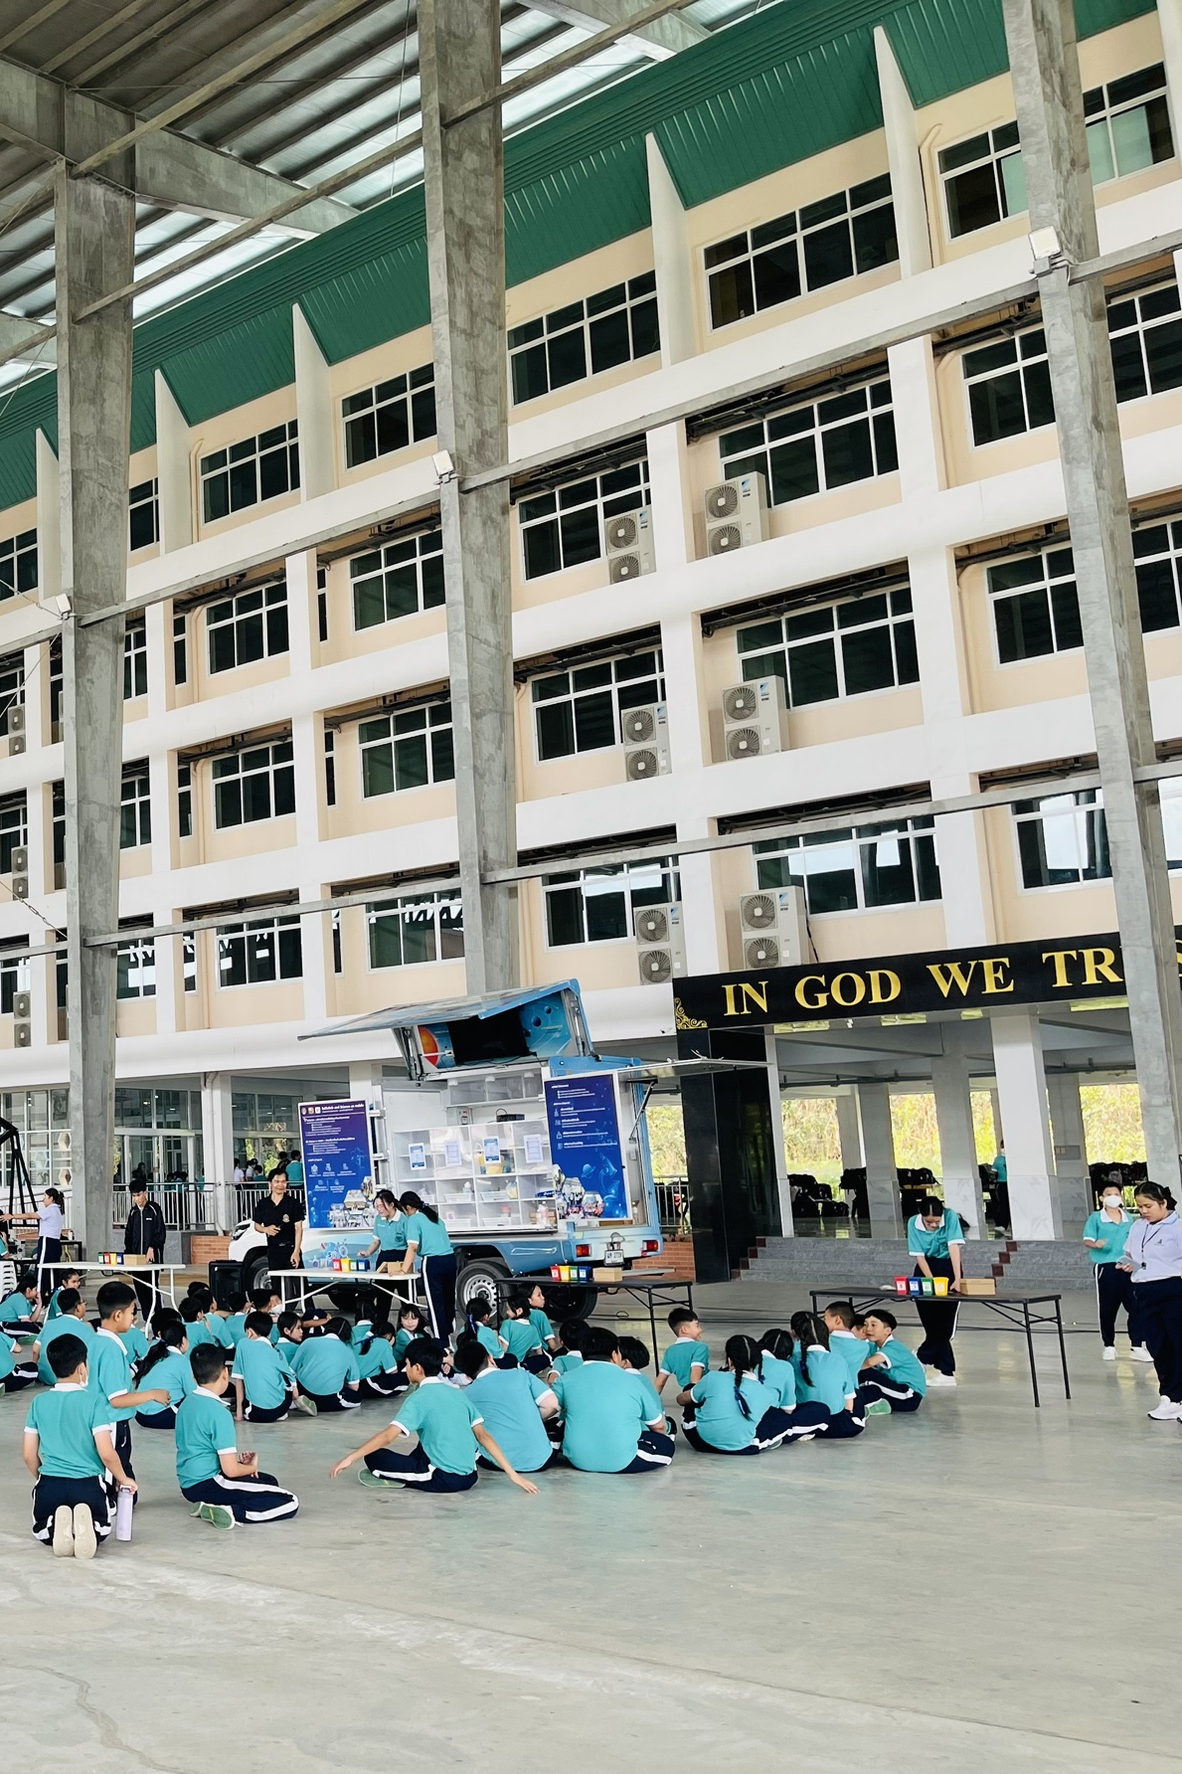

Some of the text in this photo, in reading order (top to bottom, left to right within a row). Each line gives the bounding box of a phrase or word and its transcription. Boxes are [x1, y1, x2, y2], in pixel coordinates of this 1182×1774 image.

[723, 946, 1124, 1017] IN GOD WE TR
